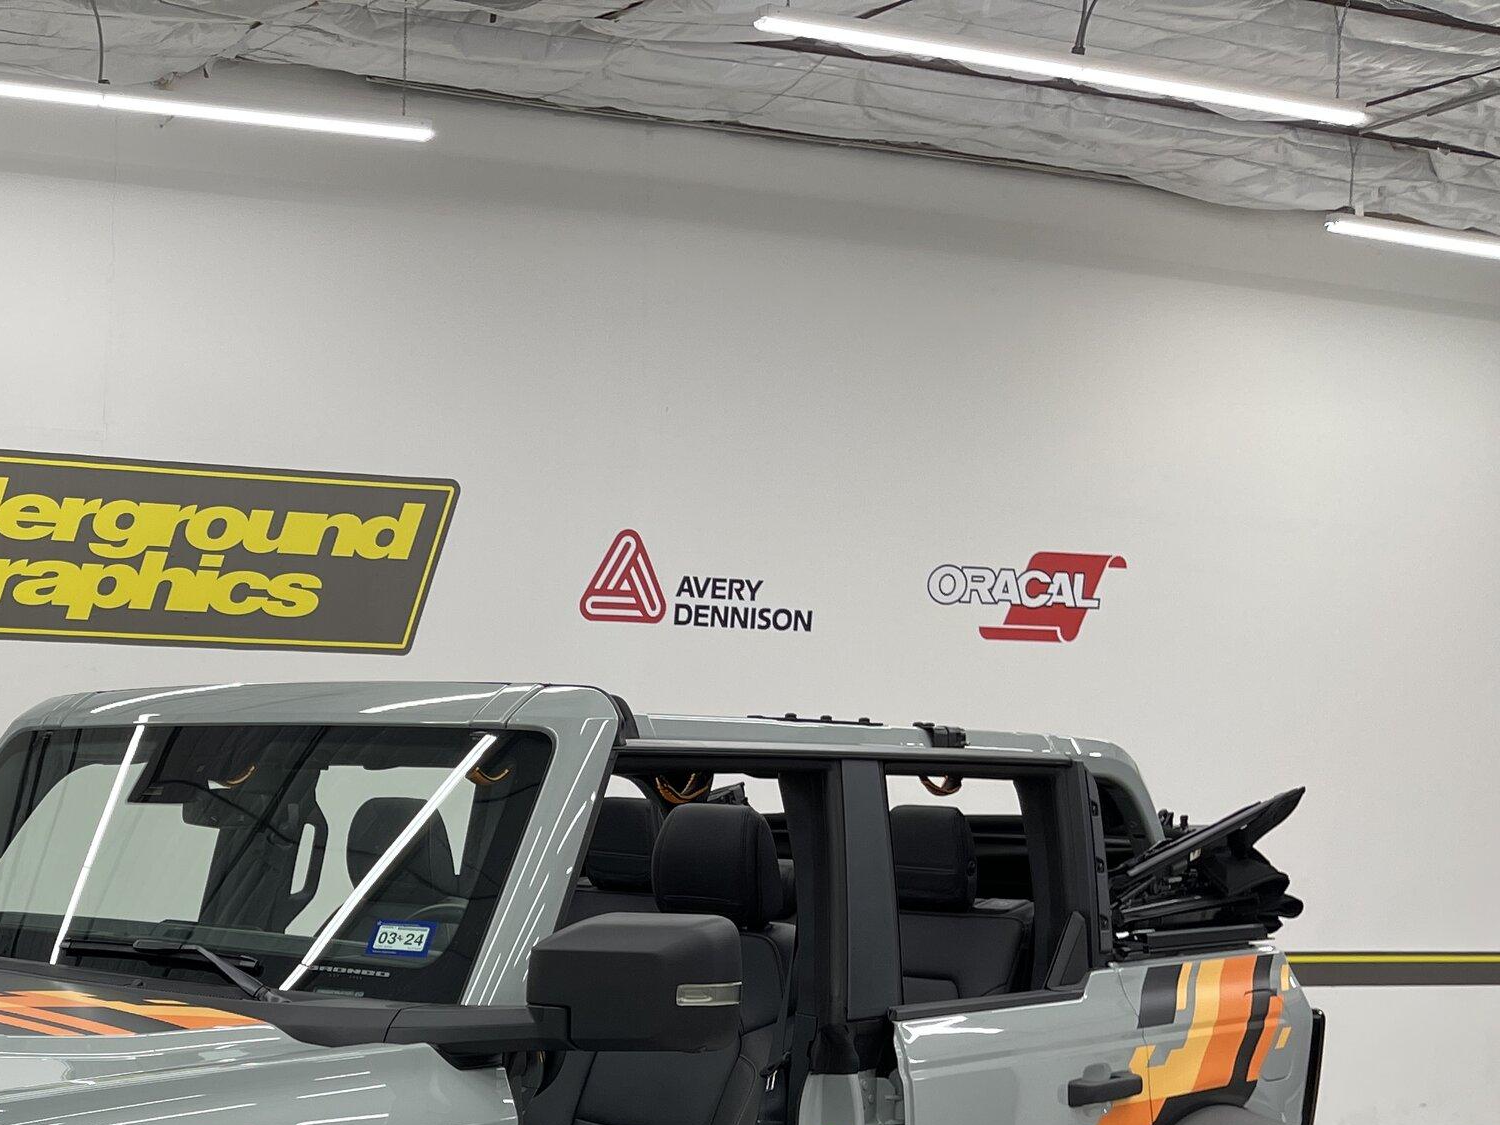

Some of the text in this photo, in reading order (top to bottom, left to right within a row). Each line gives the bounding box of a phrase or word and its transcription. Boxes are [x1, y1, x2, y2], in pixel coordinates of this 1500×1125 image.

[675, 575, 764, 602] AVERY
[927, 564, 1100, 609] ORACAL
[673, 603, 813, 632] DENNISON
[378, 932, 425, 946] 03 24
